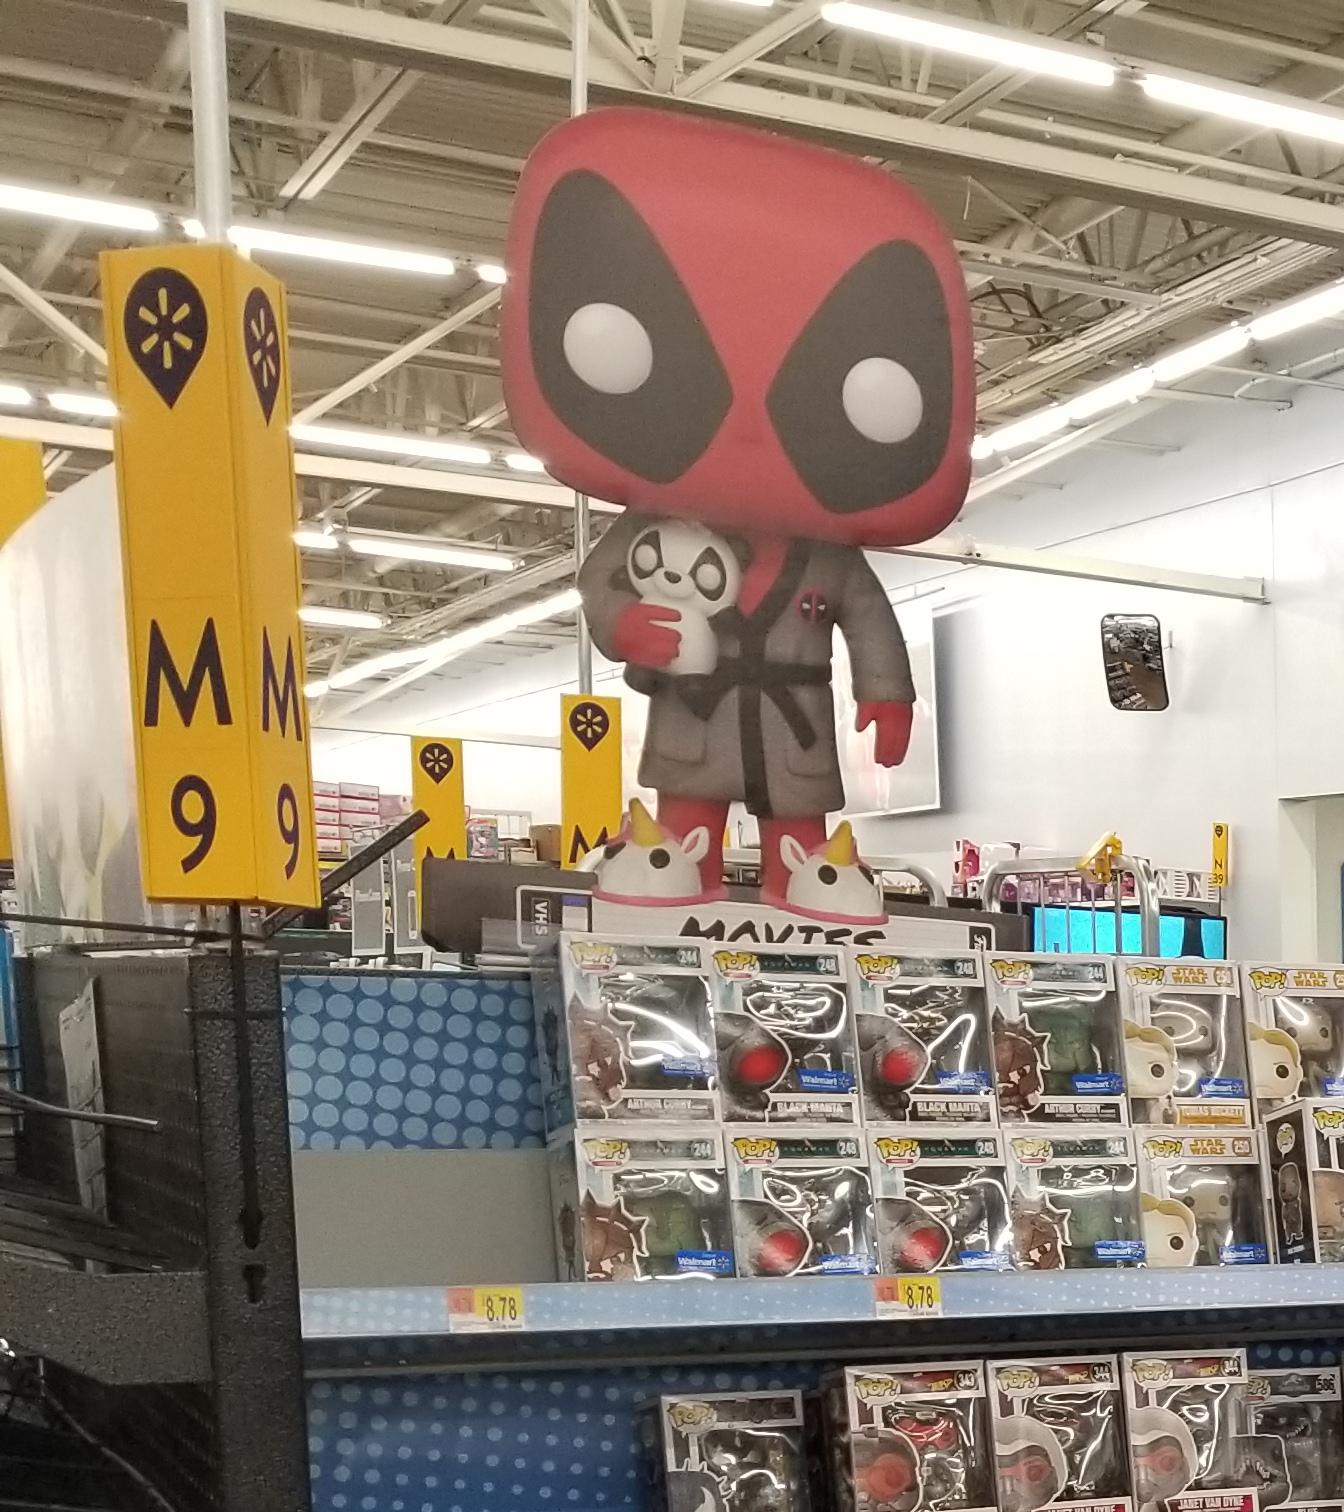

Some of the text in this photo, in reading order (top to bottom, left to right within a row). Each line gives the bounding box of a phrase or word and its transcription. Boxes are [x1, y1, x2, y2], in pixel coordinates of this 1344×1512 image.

[144, 617, 234, 728] M
[262, 625, 303, 741] M
[171, 774, 217, 874] 9
[277, 783, 300, 880] 9
[534, 900, 549, 937] VHS
[677, 1257, 718, 1268] Walmart
[486, 1295, 518, 1322] 8.78
[907, 1284, 934, 1309] 8.78
